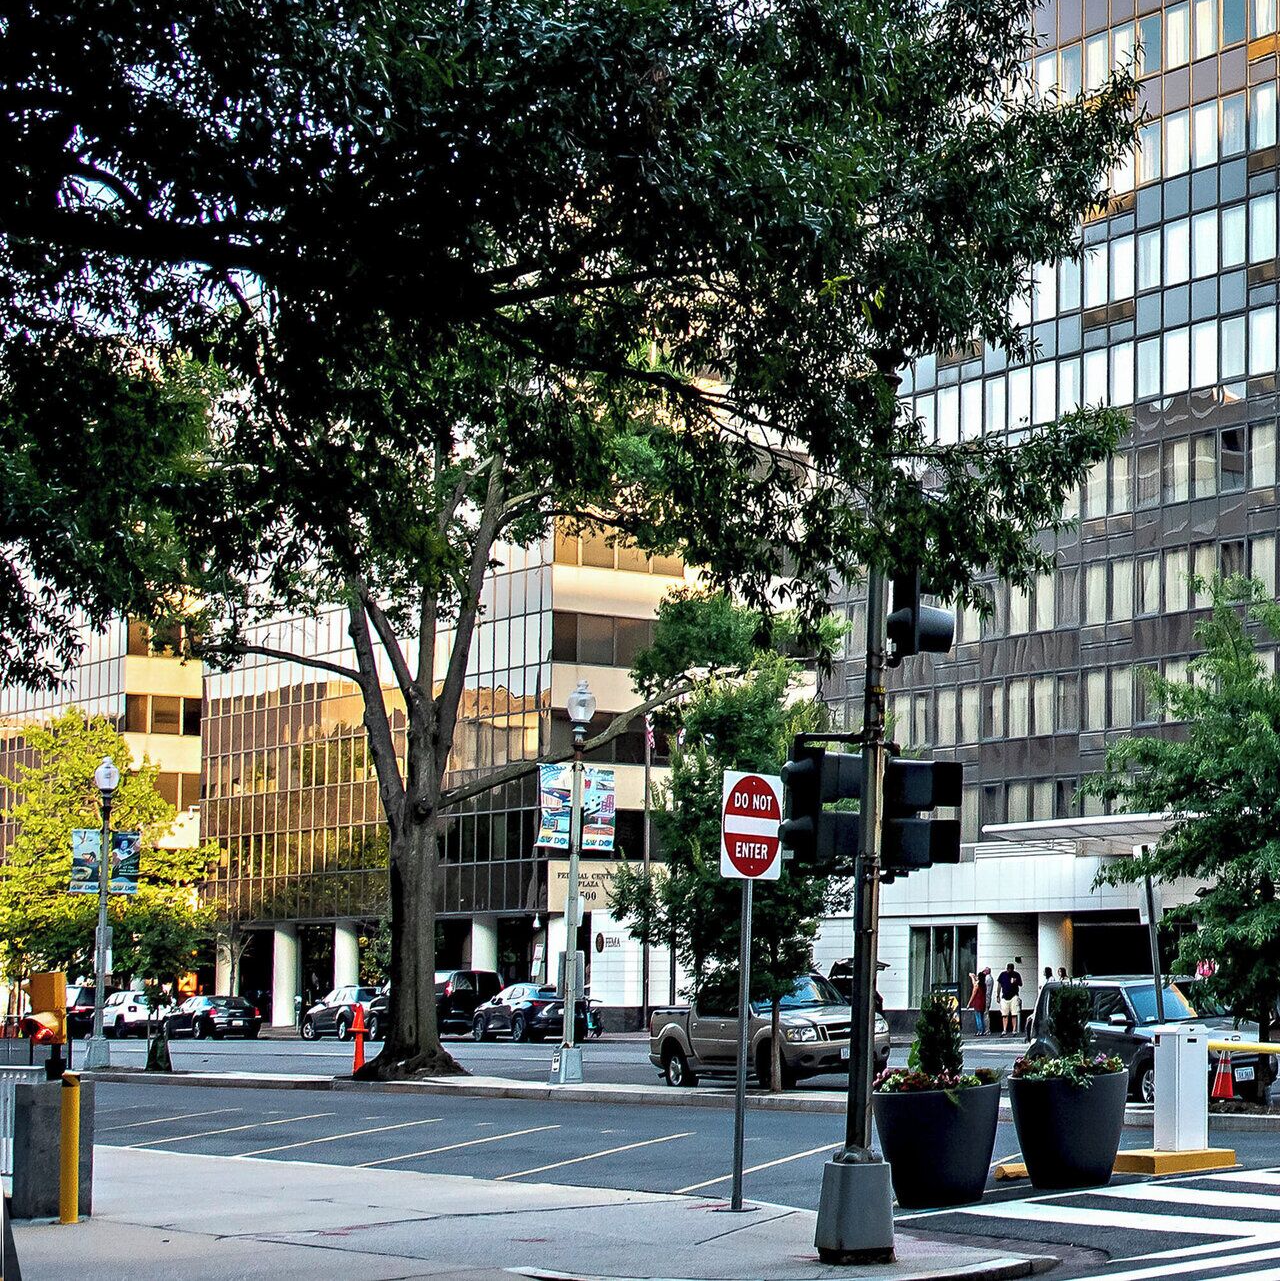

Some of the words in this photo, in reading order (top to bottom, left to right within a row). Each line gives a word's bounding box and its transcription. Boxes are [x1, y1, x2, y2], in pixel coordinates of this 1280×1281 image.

[734, 791, 749, 809] DO
[752, 794, 772, 811] NOT
[735, 841, 768, 860] ENTER
[605, 937, 621, 947] FEMA
